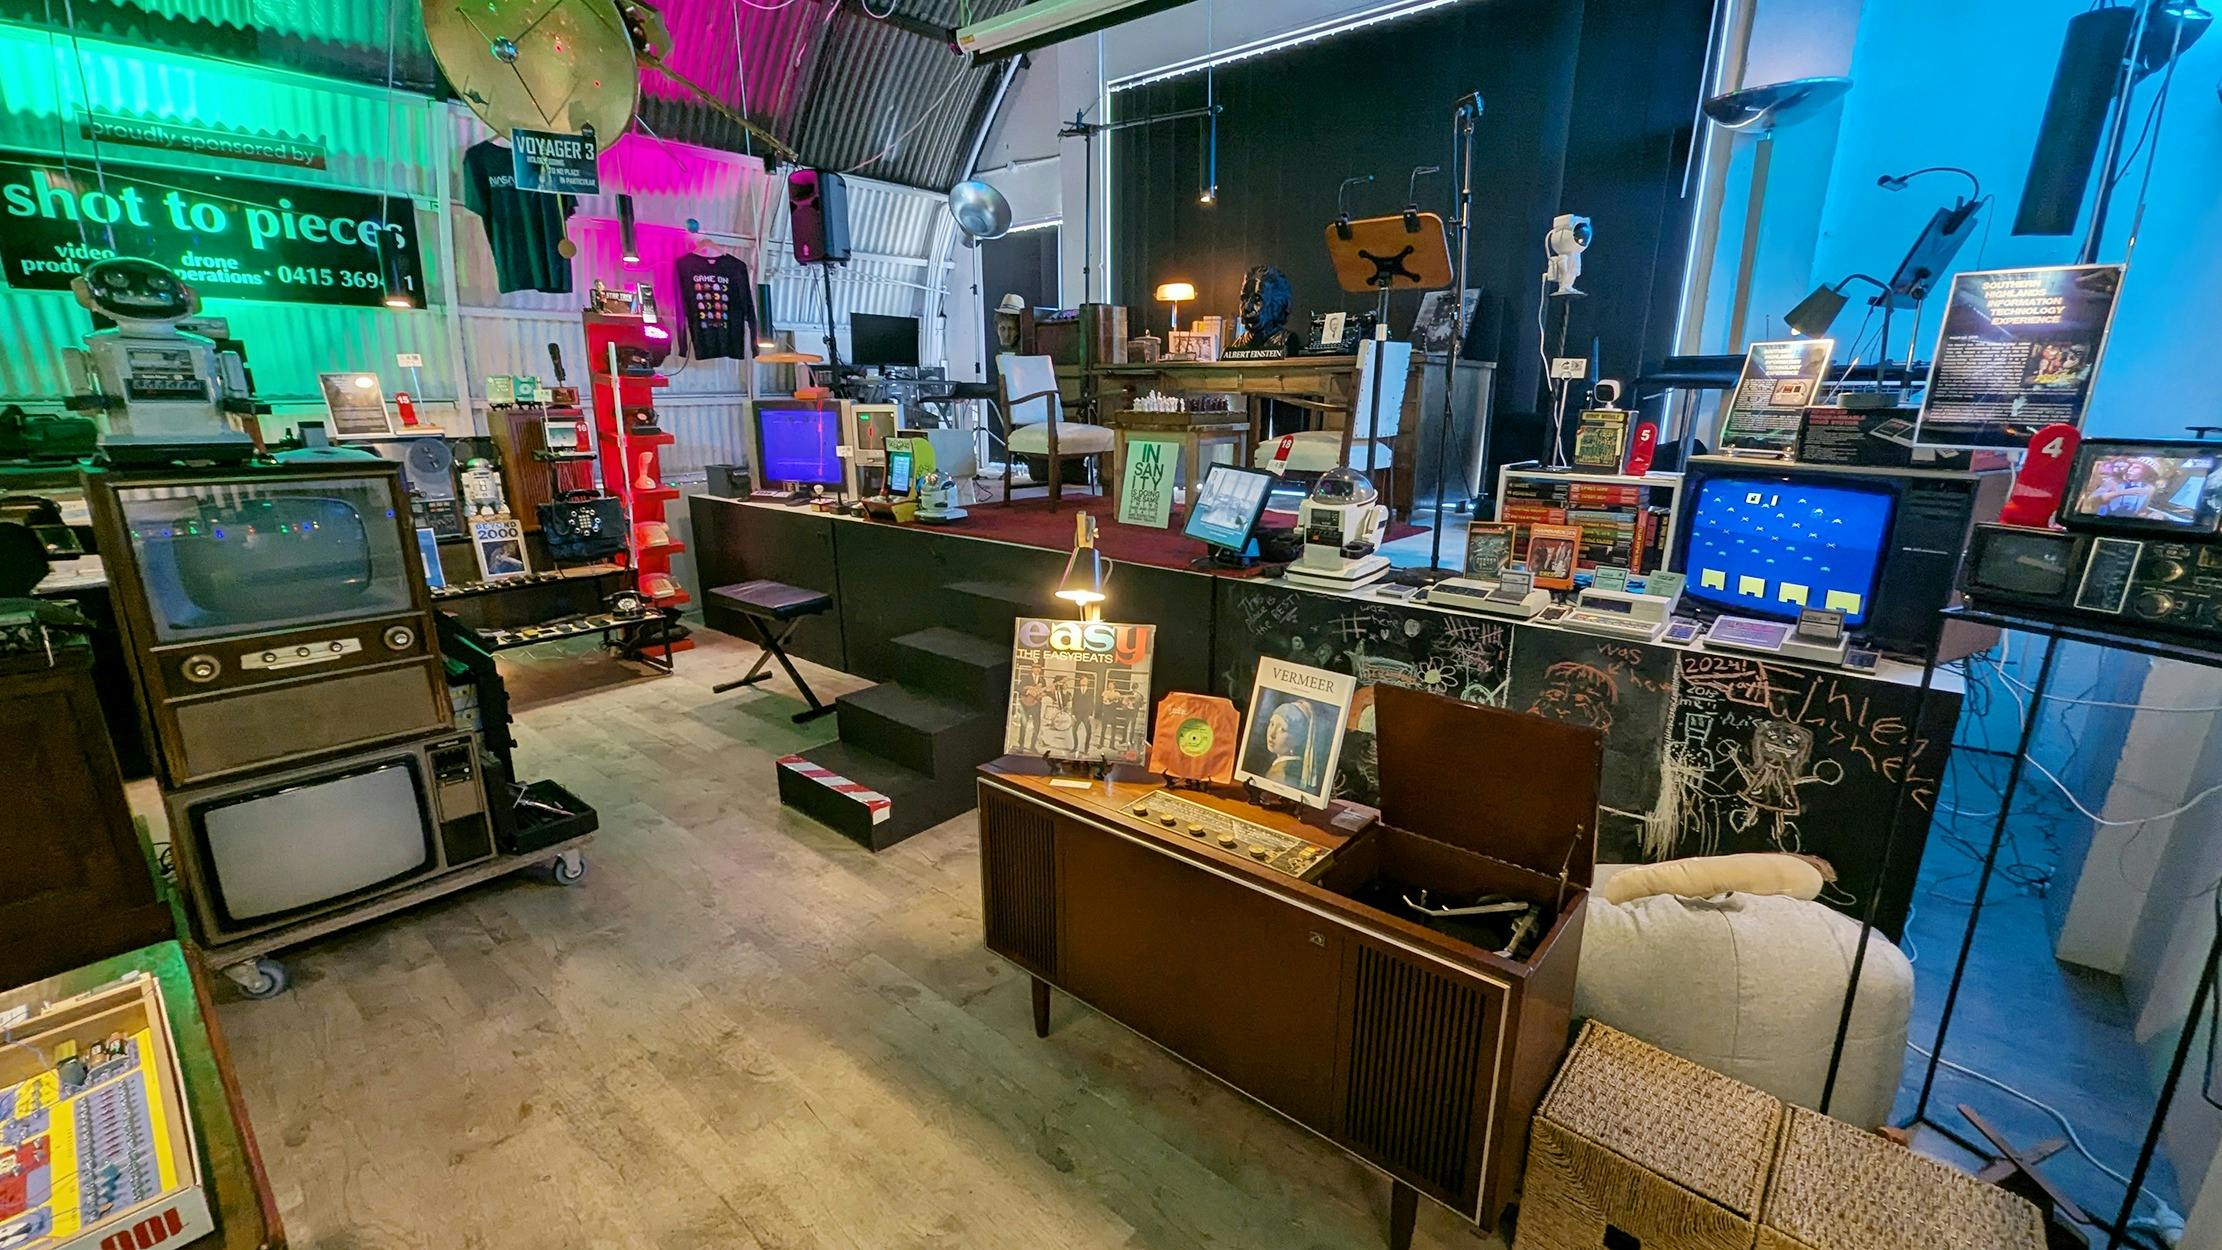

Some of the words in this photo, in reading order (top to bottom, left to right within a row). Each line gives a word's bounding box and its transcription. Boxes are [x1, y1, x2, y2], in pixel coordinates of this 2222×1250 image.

[91, 121, 177, 148] proudly
[182, 133, 288, 160] sponsored
[291, 144, 315, 166] by
[515, 135, 581, 160] VOYAGER
[585, 143, 595, 161] 3
[3, 168, 150, 227] shot
[163, 190, 226, 233] to
[245, 198, 406, 250] pieces
[54, 242, 116, 261] video
[181, 250, 239, 270] drone
[277, 264, 335, 287] 0415
[693, 275, 716, 284] GAME
[717, 276, 729, 285] ON
[1982, 279, 2042, 290] SOUTHERN
[1984, 288, 2048, 299] HIGHLANDS
[1986, 296, 2064, 308] INFORMATION
[1989, 306, 2066, 317] TECHNOLOGY
[1990, 315, 2062, 326] EXPERIENCE
[1224, 350, 1251, 359] ALBERT
[1250, 349, 1282, 358] EINSTEIN
[397, 395, 410, 405] 15
[1640, 429, 1650, 441] 5
[1281, 439, 1292, 449] 18
[2042, 437, 2065, 458] 4
[1142, 443, 1161, 464] IN
[1134, 461, 1165, 478] SAN
[475, 520, 517, 531] BEYOND
[478, 527, 518, 541] 2000
[1018, 620, 1150, 666] easy
[1017, 649, 1041, 661] THE
[1043, 650, 1114, 665] EASYBEATS
[1684, 657, 1748, 673] 2024!
[1272, 666, 1335, 694] VERMEER
